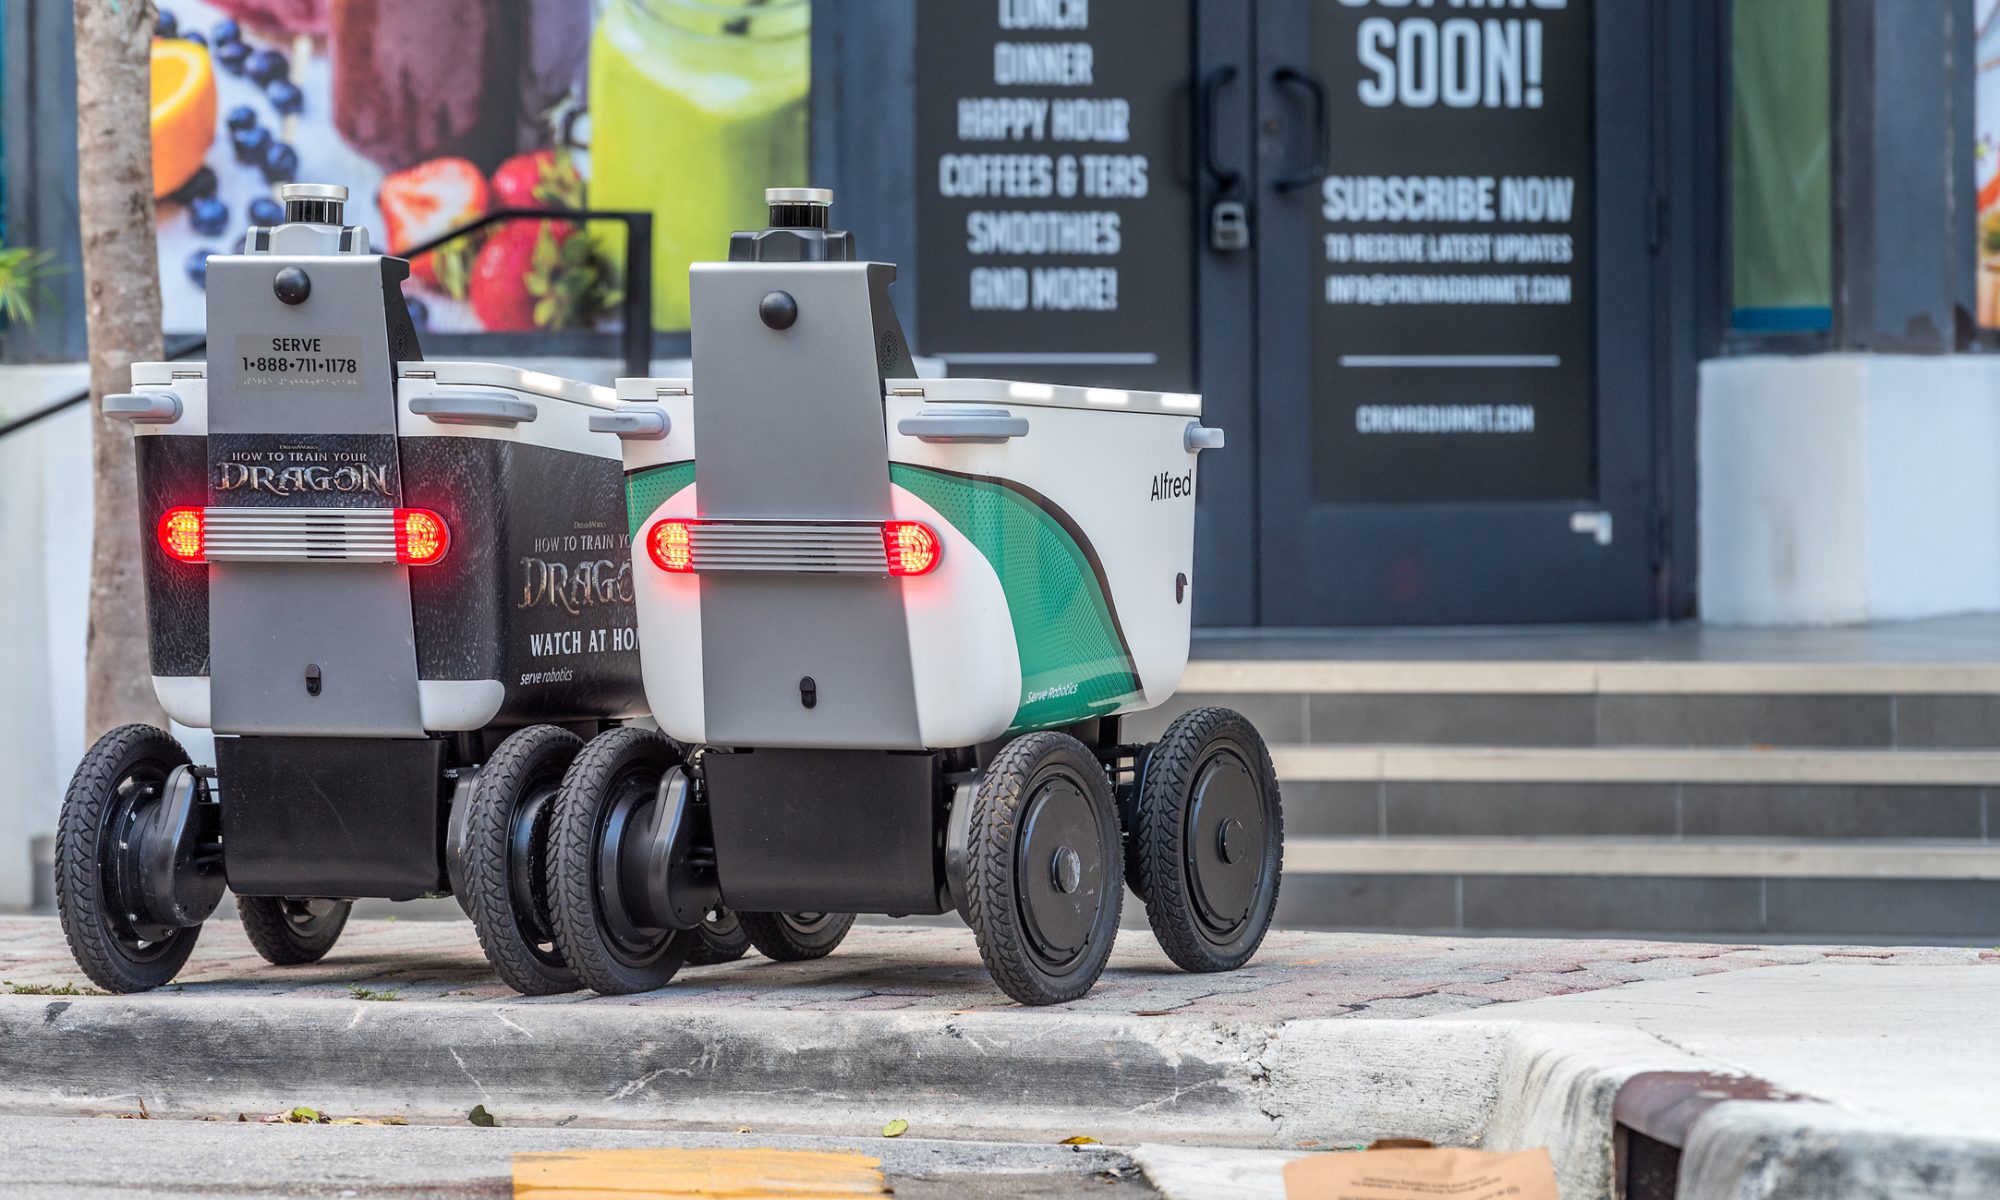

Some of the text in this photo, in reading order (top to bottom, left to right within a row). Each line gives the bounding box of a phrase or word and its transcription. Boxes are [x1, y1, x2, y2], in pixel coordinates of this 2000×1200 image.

[998, 0, 1088, 29] LUNCH
[994, 42, 1093, 86] DINNER
[1357, 17, 1543, 108] SOON!
[957, 98, 1129, 142] HAPPY HOUR
[939, 154, 1053, 197] COFFEES
[1056, 154, 1077, 197] &
[1322, 175, 1574, 222] SUBSCRIBE NOW
[966, 211, 1121, 254] SMOOTHIES
[1324, 234, 1572, 263] TO RECEIVE LATEST UPDATES
[970, 267, 1118, 310] AND MORE!
[272, 338, 321, 352] SERVE
[232, 452, 367, 462] HOW TO TRAIN YOUR
[215, 461, 394, 496] DRAGON
[1151, 469, 1192, 501] Alfred
[535, 533, 631, 553] HOW TO TRAIN YO
[517, 556, 634, 616] DRAGO
[530, 627, 639, 657] WATCH AT HO
[519, 666, 574, 686] serve robotics
[1026, 682, 1079, 704] Serve Robotics
